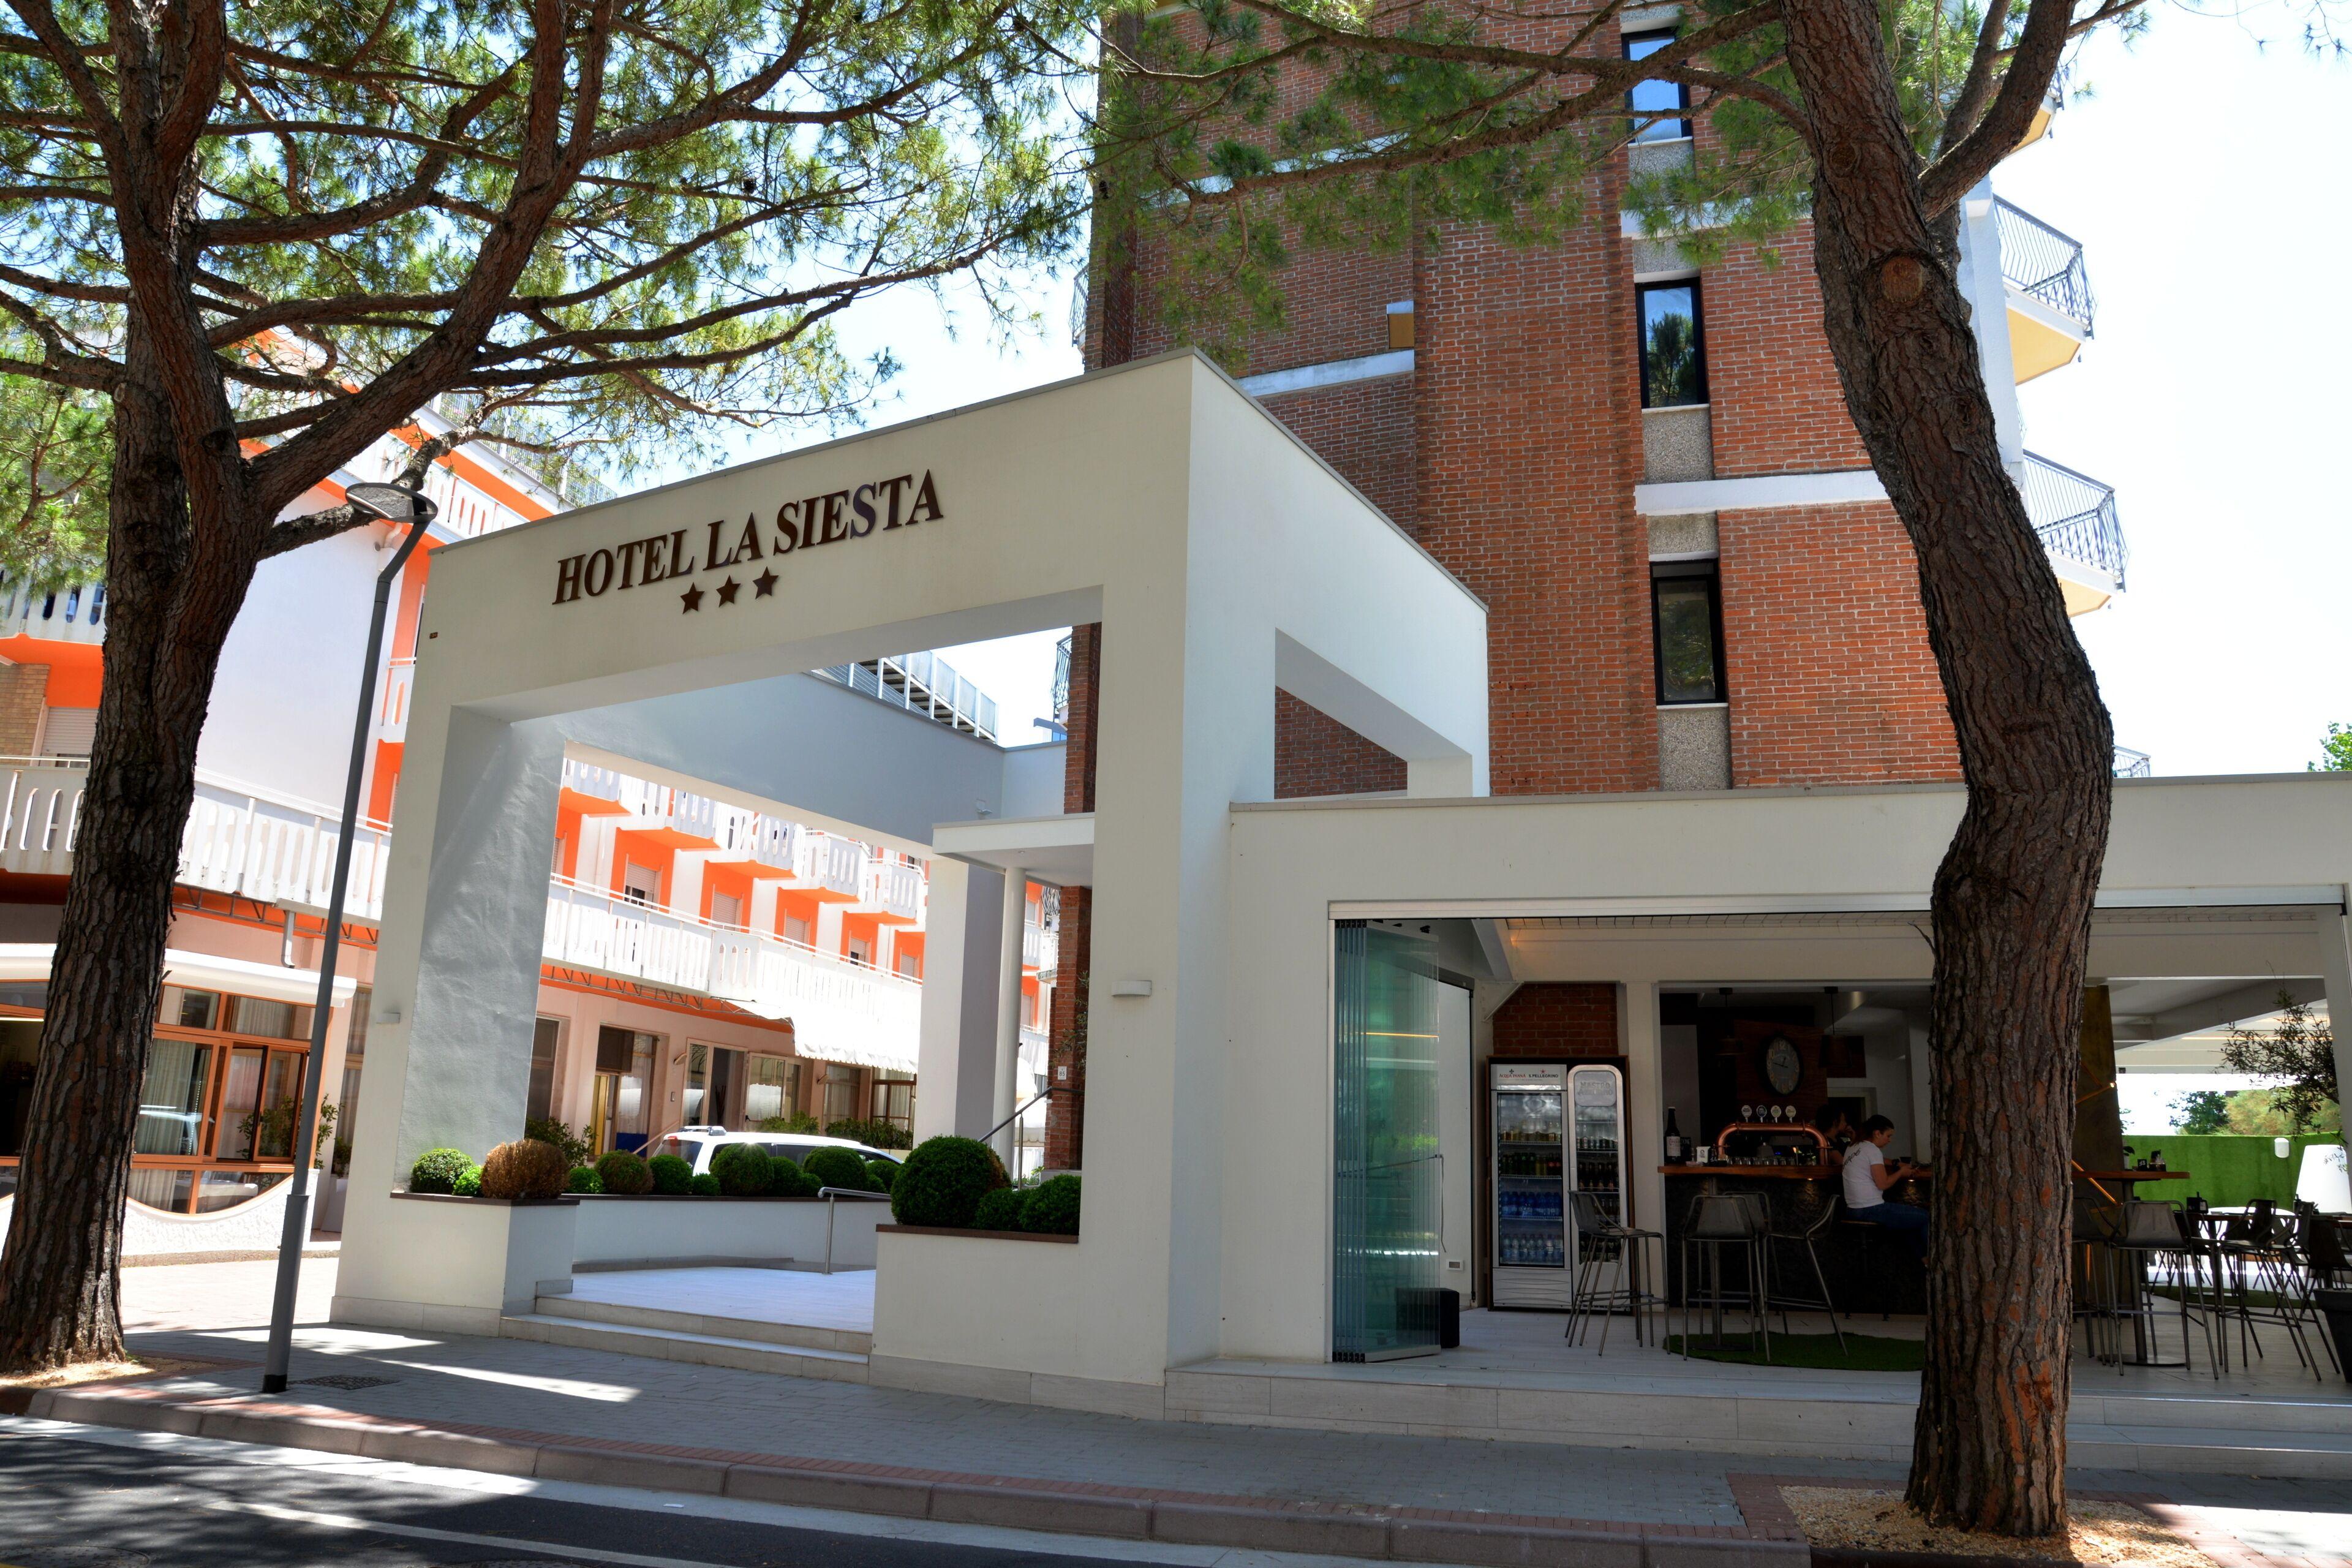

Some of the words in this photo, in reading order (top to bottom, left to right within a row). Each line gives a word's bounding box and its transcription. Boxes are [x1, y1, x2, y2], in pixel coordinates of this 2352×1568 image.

[552, 529, 695, 605] HOTEL
[703, 512, 764, 571] LA
[773, 469, 944, 556] SIESTA
